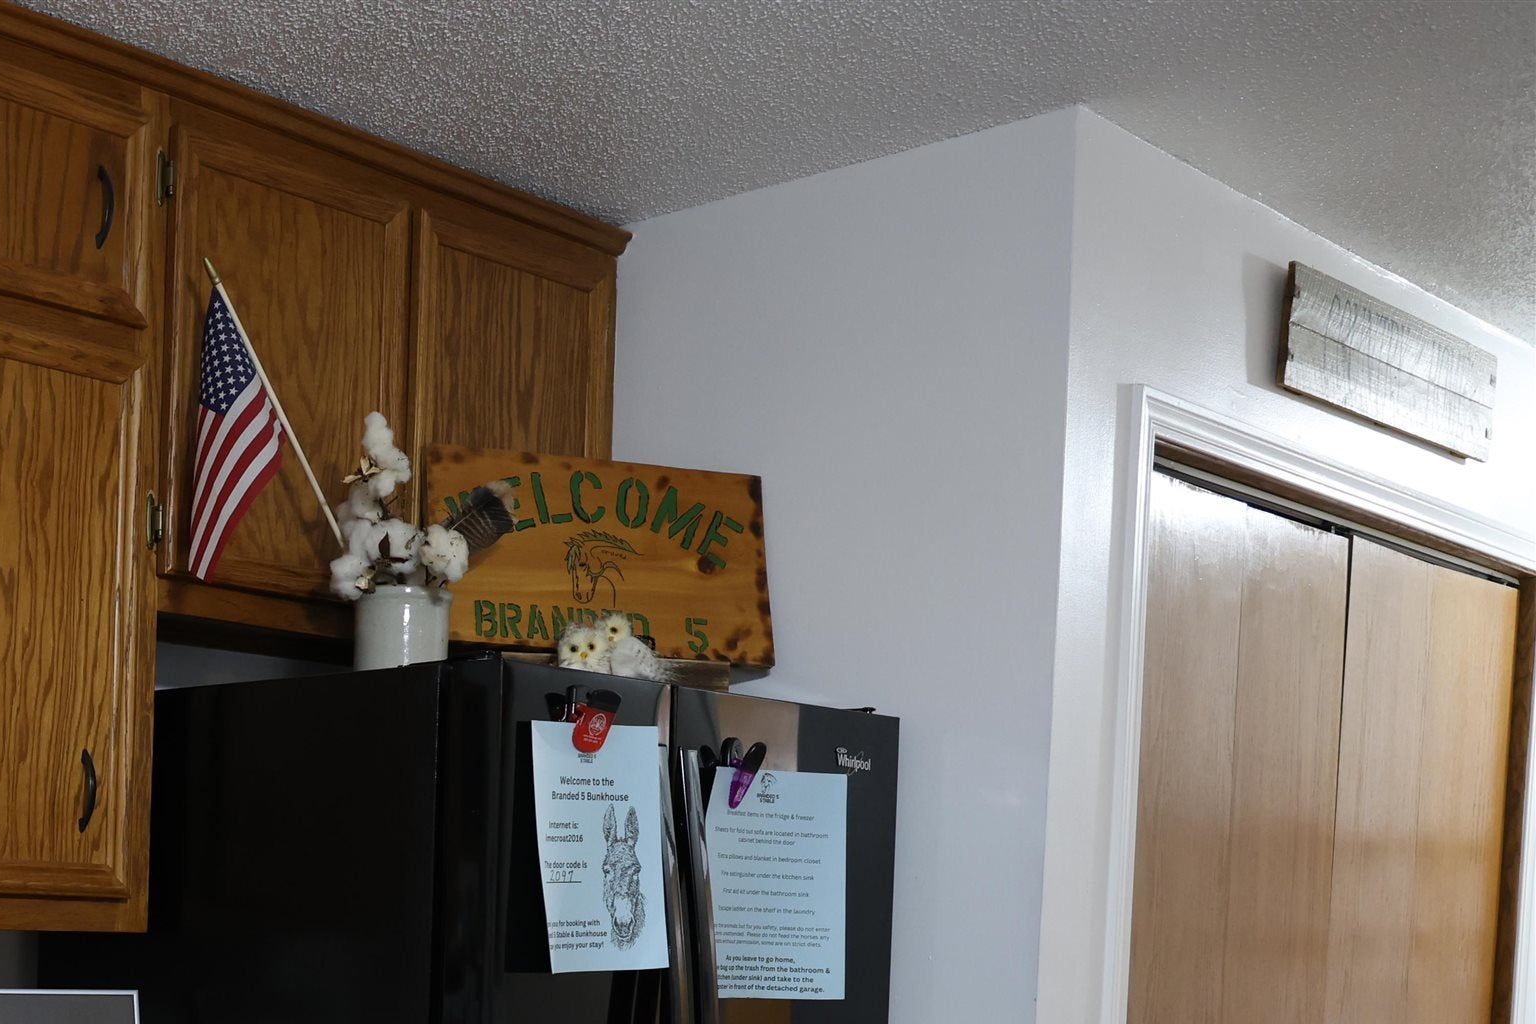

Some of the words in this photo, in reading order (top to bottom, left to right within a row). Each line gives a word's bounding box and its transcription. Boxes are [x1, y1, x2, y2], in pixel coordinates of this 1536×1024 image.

[474, 600, 650, 640] BRANDD
[685, 618, 710, 653] 5
[837, 753, 871, 772] Whirlpool
[560, 776, 591, 785] Welcome
[593, 778, 600, 786] to
[602, 777, 614, 786] the
[552, 791, 579, 800] Branded
[581, 792, 585, 800] 5
[587, 792, 629, 801] Bunkhouse
[774, 813, 789, 821] fridge
[549, 821, 571, 829] Internet
[566, 920, 586, 928] booking
[576, 942, 588, 950] your
